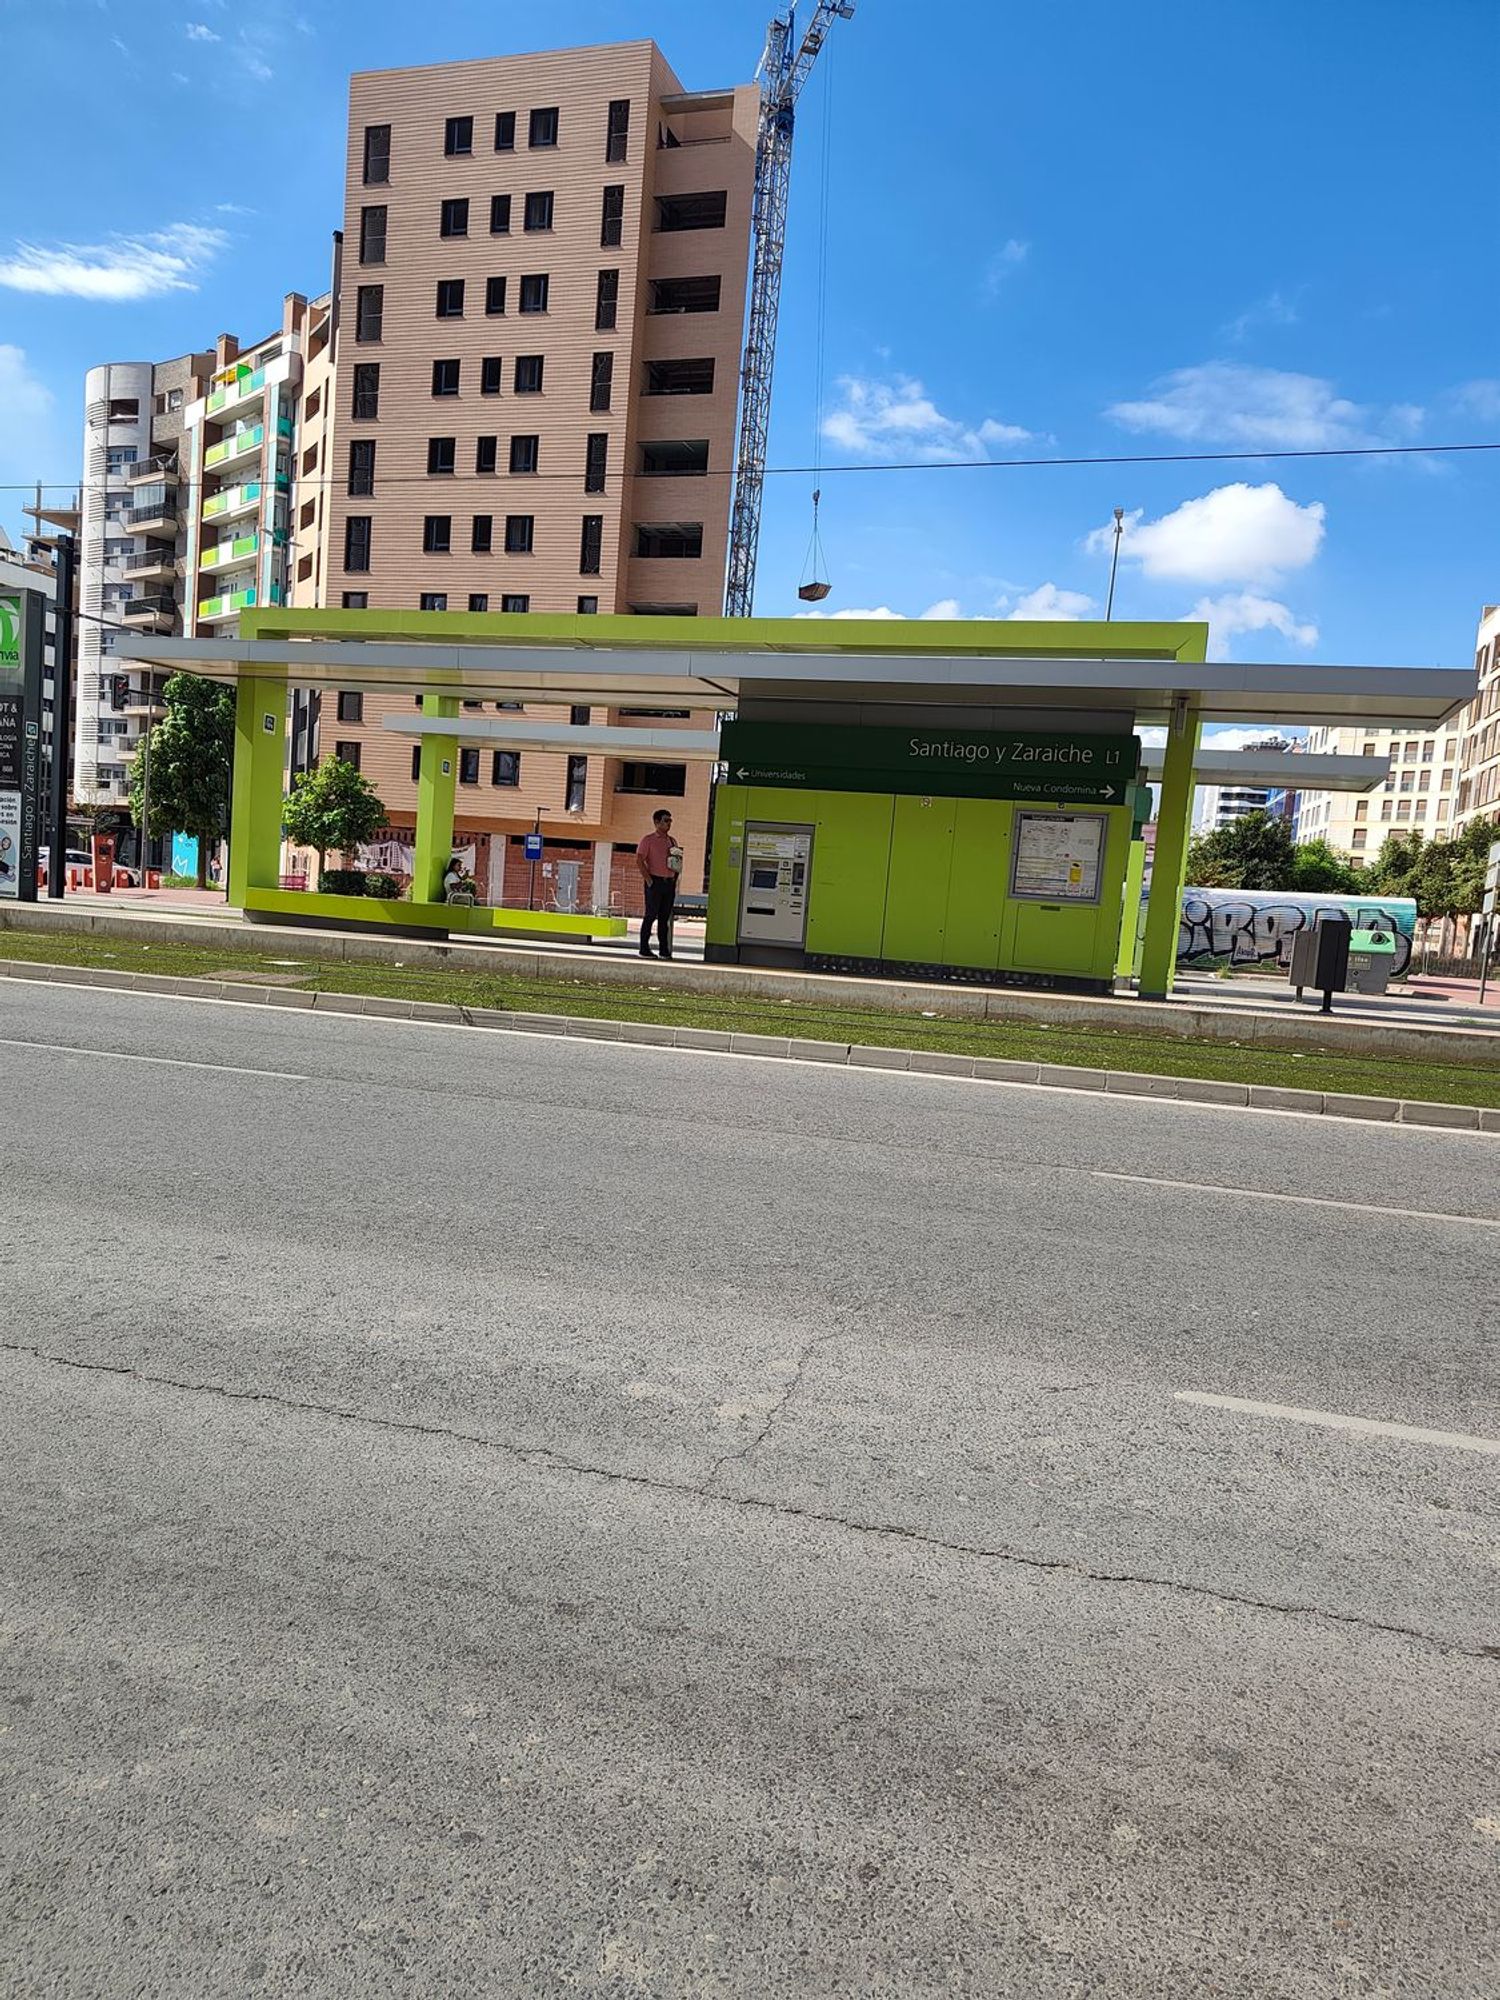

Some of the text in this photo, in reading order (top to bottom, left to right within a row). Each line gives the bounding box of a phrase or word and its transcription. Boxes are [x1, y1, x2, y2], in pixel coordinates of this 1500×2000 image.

[909, 738, 1120, 764] Santiago y Zaraiche L1
[24, 739, 36, 792] Zaraiche
[750, 767, 806, 780] Universidades
[1013, 782, 1097, 795] Nueva Condomina
[26, 794, 36, 803] y
[22, 805, 35, 860] Santiago
